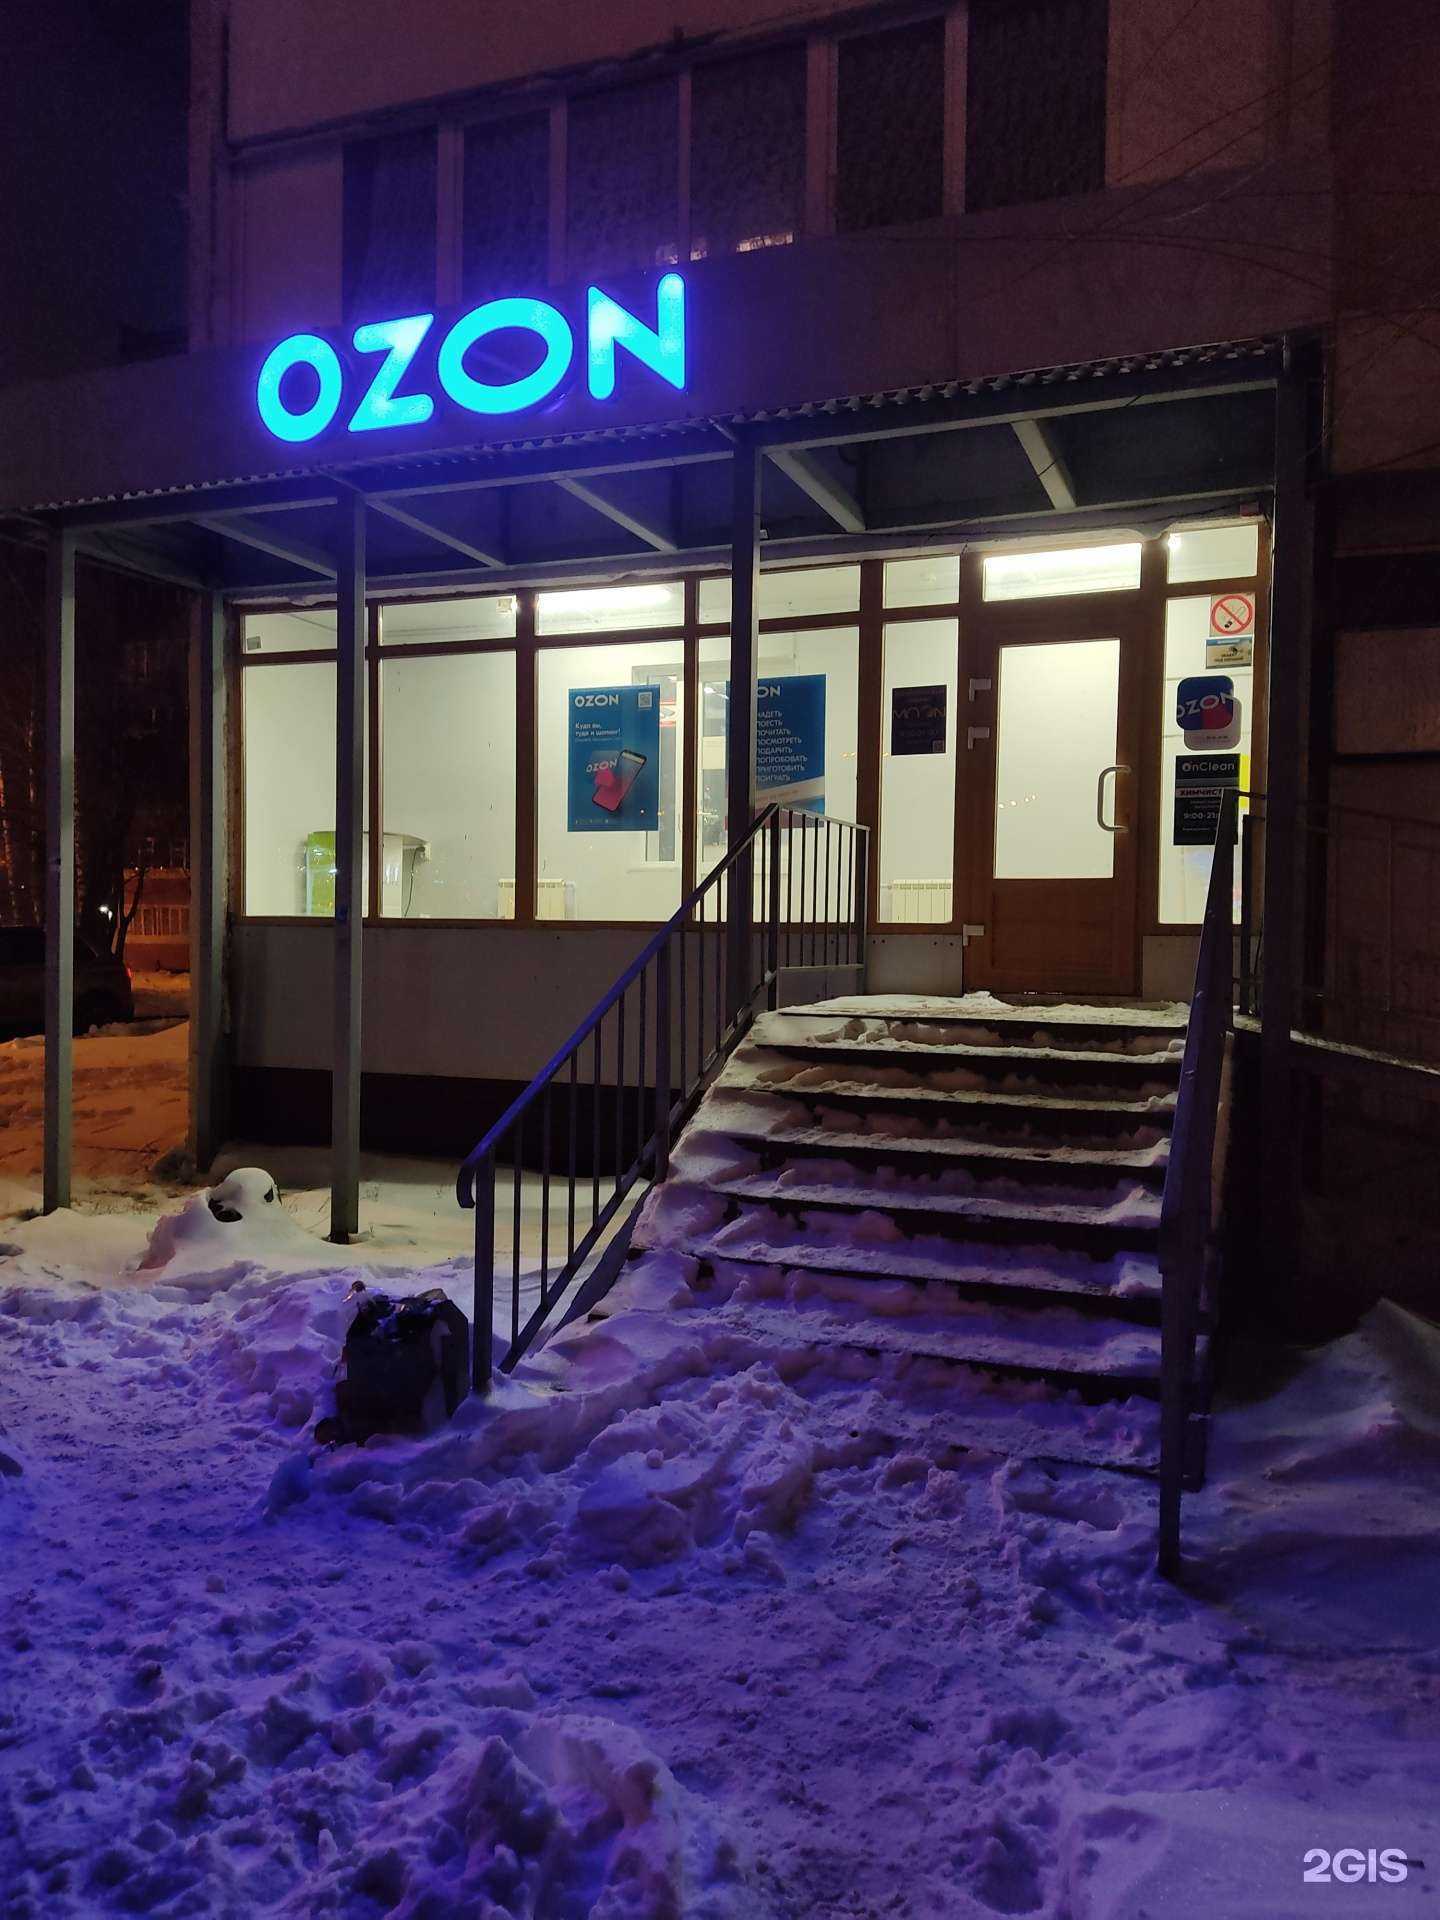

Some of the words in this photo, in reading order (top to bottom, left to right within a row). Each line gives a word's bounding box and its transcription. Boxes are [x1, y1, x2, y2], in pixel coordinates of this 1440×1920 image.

[257, 272, 686, 443] OZON
[757, 685, 781, 698] ON
[574, 693, 619, 708] OZON
[585, 758, 618, 773] OZON
[1182, 761, 1235, 772] OnClean
